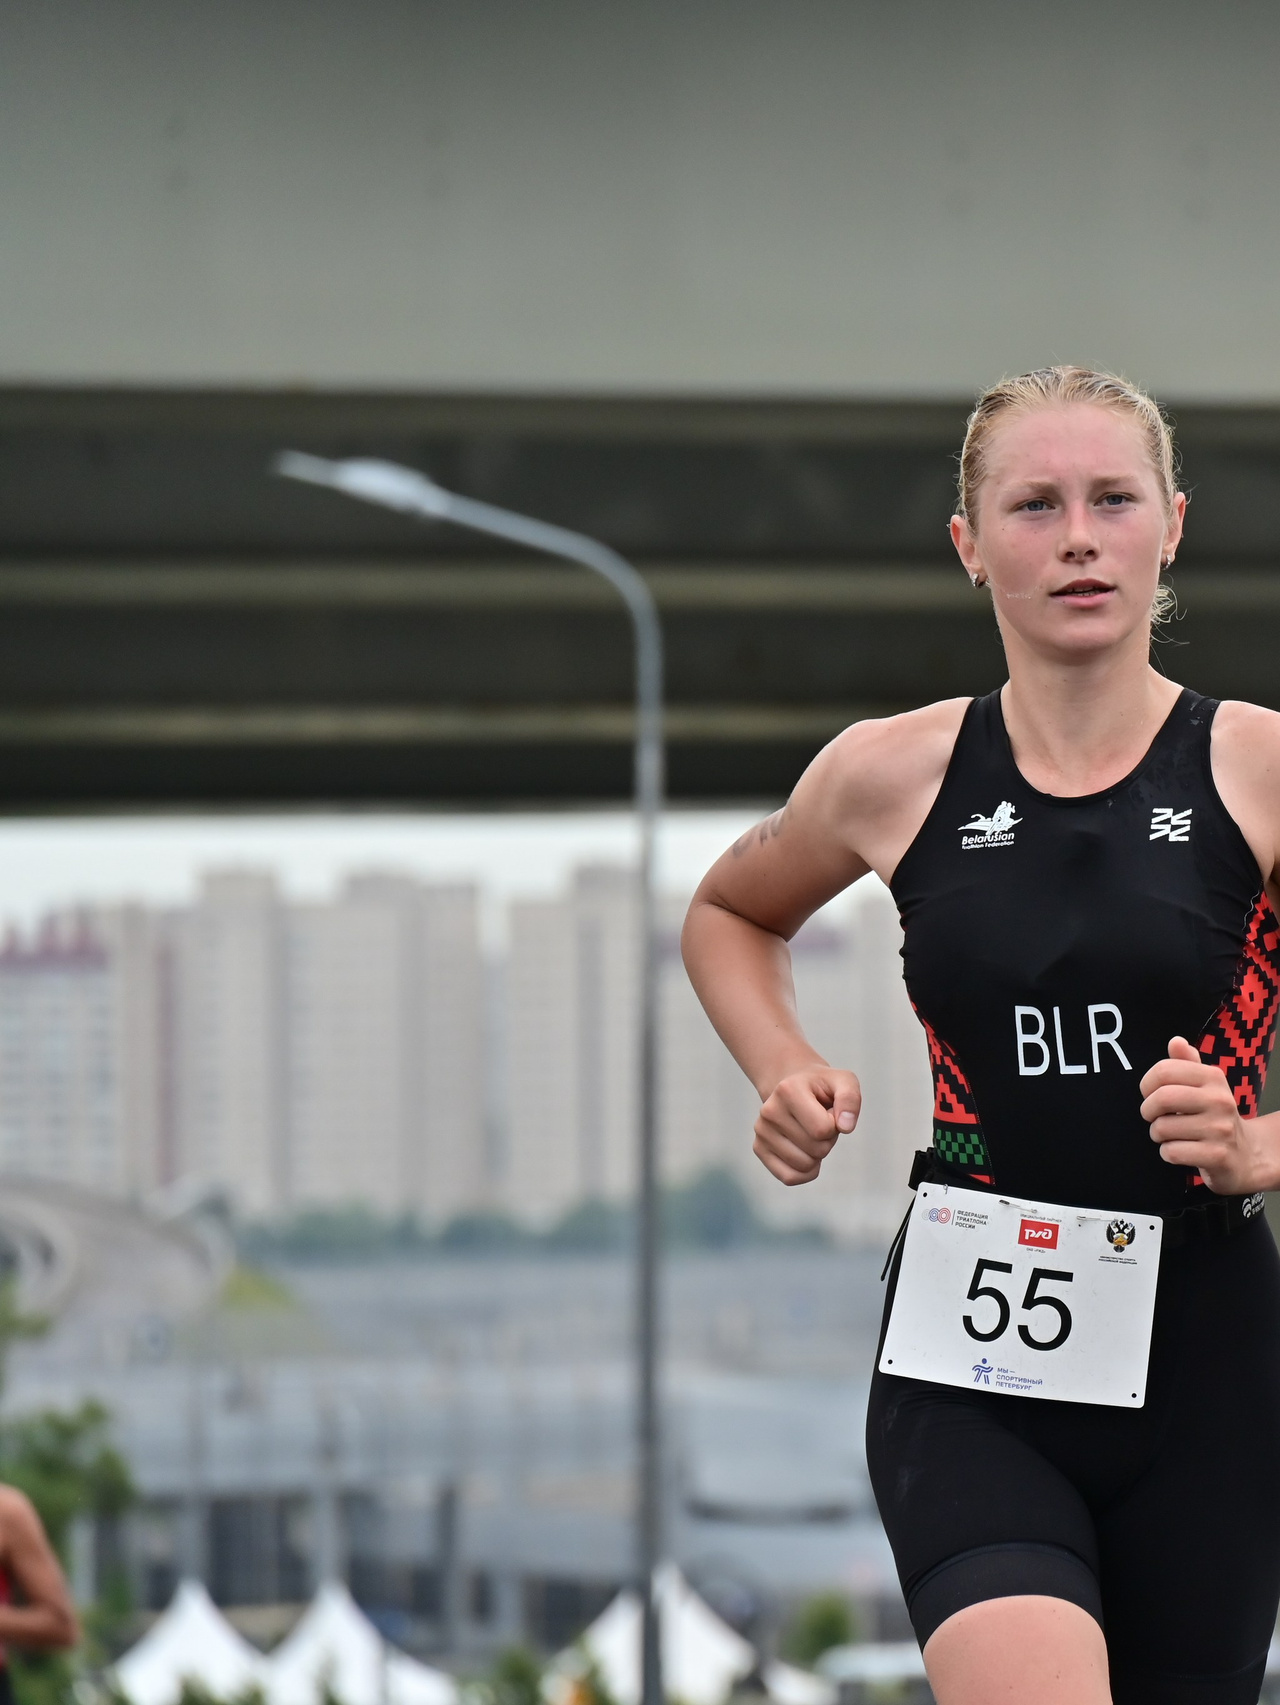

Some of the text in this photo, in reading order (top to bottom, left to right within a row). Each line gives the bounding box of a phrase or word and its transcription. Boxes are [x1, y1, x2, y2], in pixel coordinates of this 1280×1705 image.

[961, 832, 1015, 845] Belarusian
[1014, 1003, 1133, 1076] BLR
[957, 1209, 989, 1220] ФЕДЕРАЦИЯ
[954, 1221, 976, 1230] РОССИИ
[956, 1215, 987, 1226] ТРИАТЛОНА
[962, 1258, 1074, 1352] 55
[996, 1374, 1043, 1386] СПОРТИВНЫЙ
[995, 1381, 1032, 1391] ПЕТЕРБУРГ
